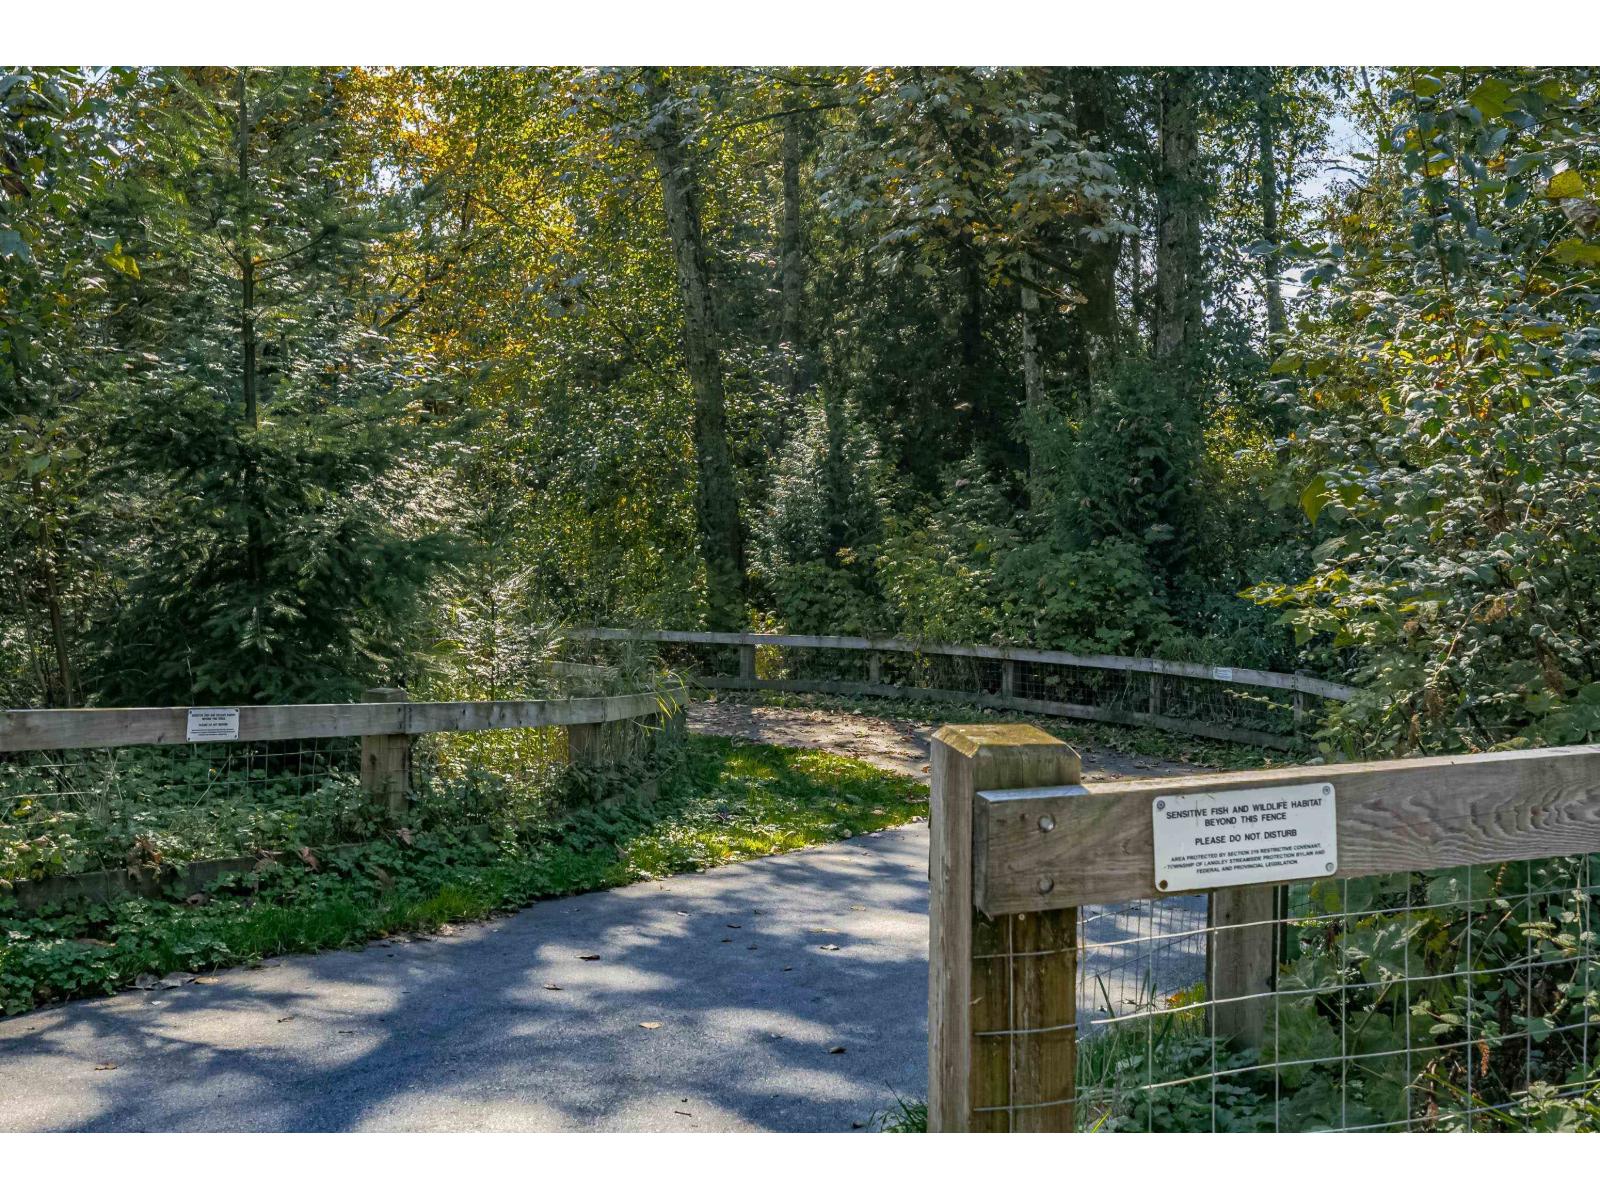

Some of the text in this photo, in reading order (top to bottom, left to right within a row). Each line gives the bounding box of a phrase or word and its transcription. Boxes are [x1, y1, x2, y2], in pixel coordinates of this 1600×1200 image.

[1166, 798, 1322, 819] SENSITIVE FISH AND WILDLIFE HABITAT
[1204, 812, 1286, 826] BEYOND THIS FENCE
[1194, 830, 1297, 846] PLEASE DO NOT DISTURB
